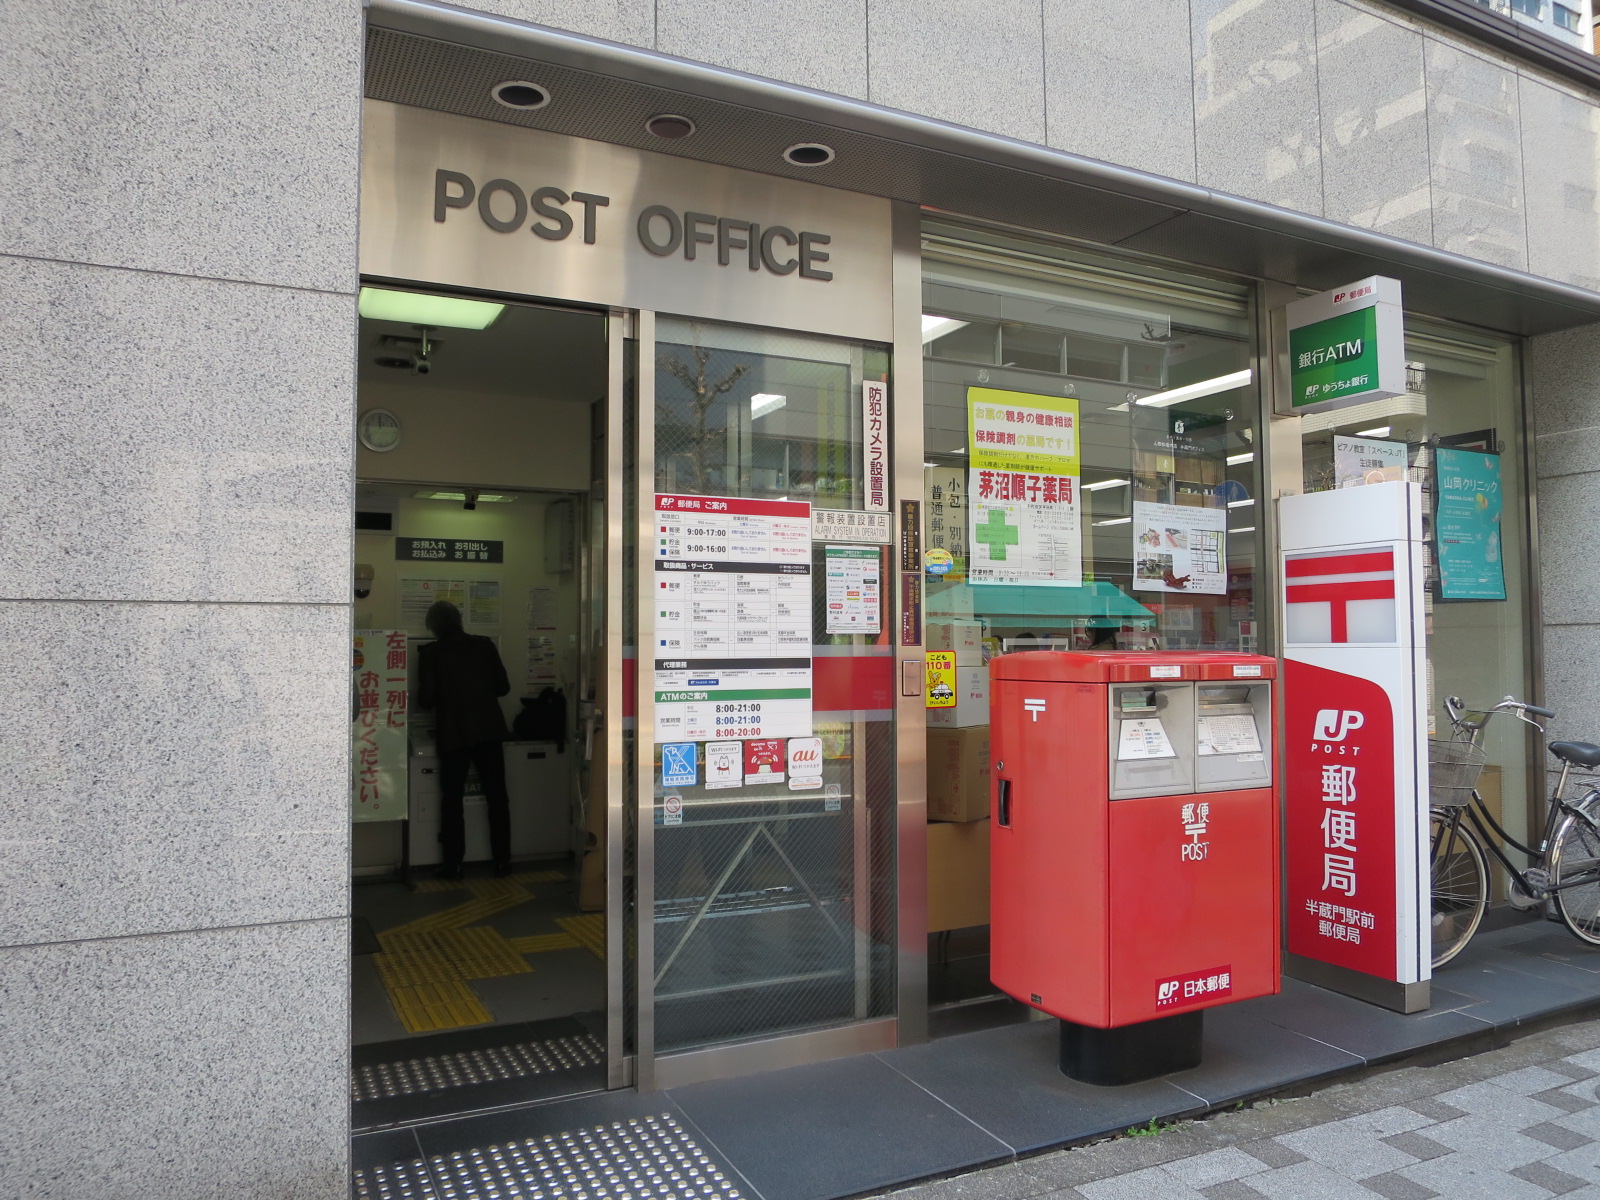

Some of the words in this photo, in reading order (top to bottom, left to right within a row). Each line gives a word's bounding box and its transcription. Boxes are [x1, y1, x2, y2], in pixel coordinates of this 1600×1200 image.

[433, 168, 610, 245] POST
[637, 204, 833, 281] OFFICE
[1350, 286, 1372, 299] 郵便局
[1298, 338, 1362, 369] 銀行ATM
[1322, 374, 1368, 393] ゆうちょ銀行
[975, 407, 1073, 428] お薬の親身の健康相談
[869, 386, 883, 507] 防犯カメラ設置局
[1360, 458, 1384, 468] 生徒募集
[979, 470, 1073, 504] 茅沼順子薬局
[1443, 475, 1498, 493] 山岡クリニック
[677, 500, 700, 509] 郵便局
[704, 501, 727, 510] ご案内
[816, 512, 886, 527] 警報装置設置店
[930, 485, 944, 550] 普通郵便
[687, 528, 726, 537] 9:00-17:00
[815, 525, 832, 534] ALARM
[834, 526, 853, 535] SYSTEM
[861, 528, 886, 537] OPERATION
[412, 541, 446, 550] お預入れ
[454, 542, 488, 551] お引出し
[687, 544, 726, 553] 9:00-16:00
[412, 550, 446, 558] お払込み
[663, 561, 714, 570] 取扱商品・サービス
[663, 661, 687, 669] 代理業務
[926, 661, 951, 670] 110番
[386, 631, 407, 728] 左側一列に
[660, 692, 708, 701] ATMのご案内
[716, 704, 761, 713] 8:00-21:00
[716, 716, 761, 725] 8:00-21:00
[716, 728, 761, 737] 8:00-20:00
[359, 671, 380, 810] お並びください。
[793, 750, 820, 762] au
[1311, 743, 1360, 756] POST
[1181, 802, 1210, 824] 郵便
[1320, 764, 1357, 897] 郵便局
[1181, 842, 1210, 862] POST
[1305, 899, 1375, 930] 半蔵門駅前
[1318, 919, 1361, 945] 郵便局
[1184, 973, 1230, 998] 日本郵便
[1157, 997, 1178, 1006] POST
